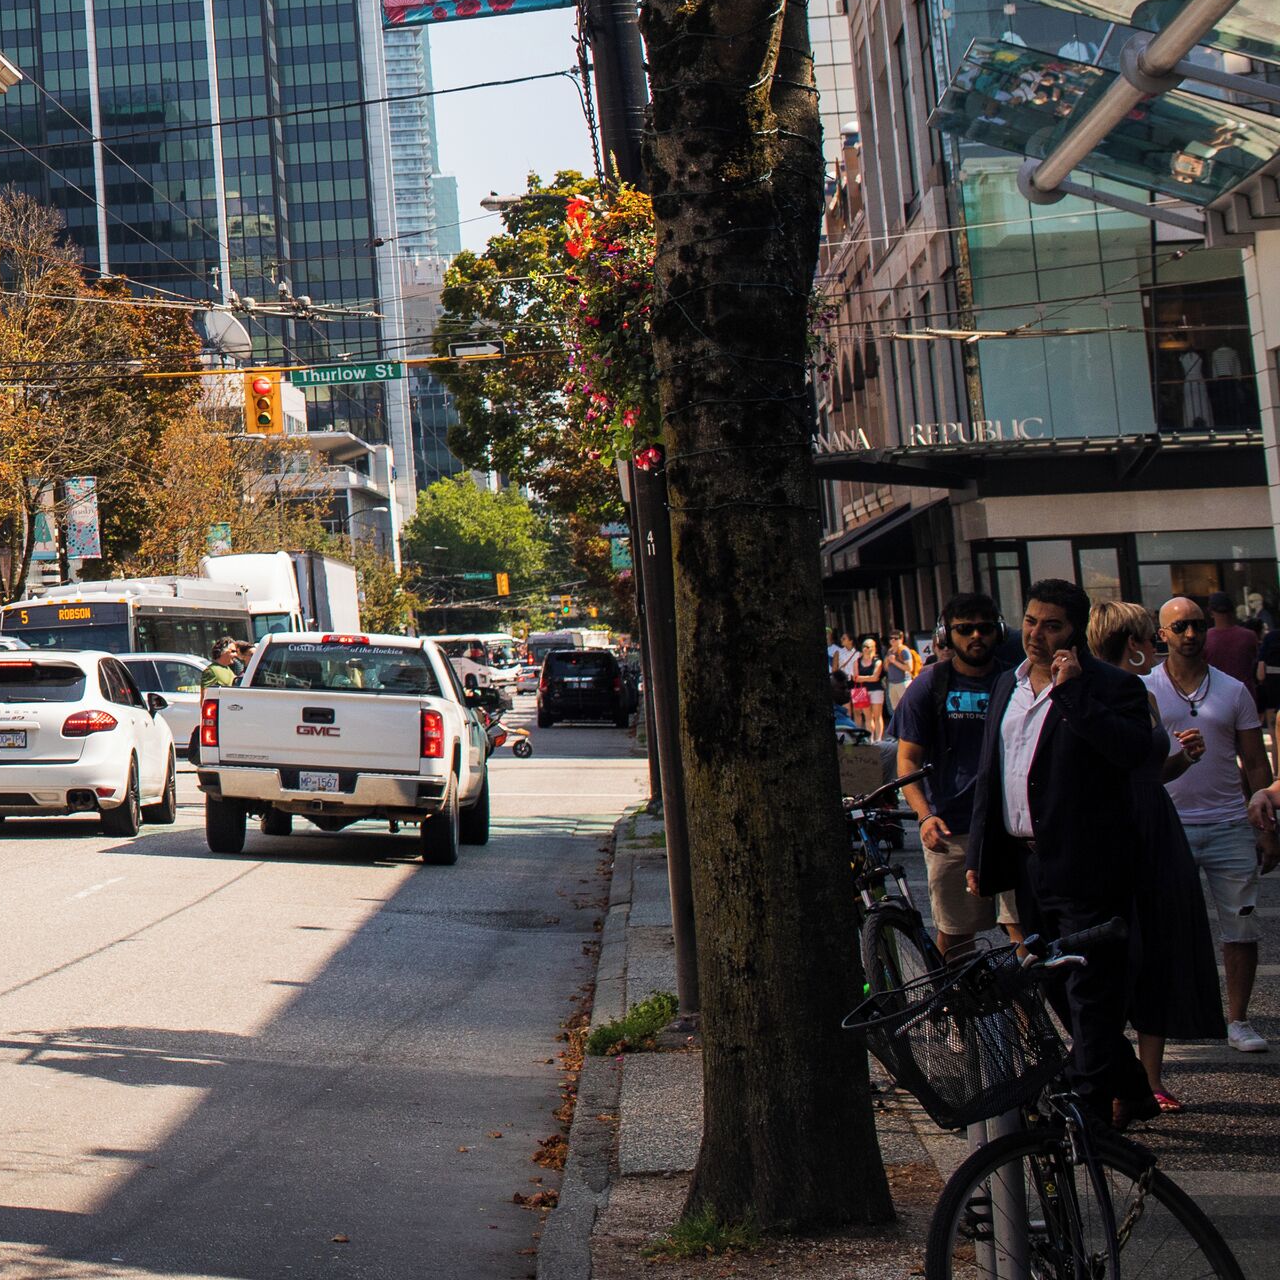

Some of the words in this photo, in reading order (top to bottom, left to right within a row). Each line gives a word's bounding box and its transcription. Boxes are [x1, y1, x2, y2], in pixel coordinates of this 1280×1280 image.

[299, 367, 367, 382] Thurlow
[375, 363, 394, 378] St
[910, 417, 1044, 446] REPUBLIC
[647, 530, 653, 543] 4
[20, 610, 29, 624] 5
[59, 608, 91, 621] ROBSON
[373, 647, 403, 655] Rockies
[923, 645, 931, 655] 4
[296, 725, 340, 737] GMC
